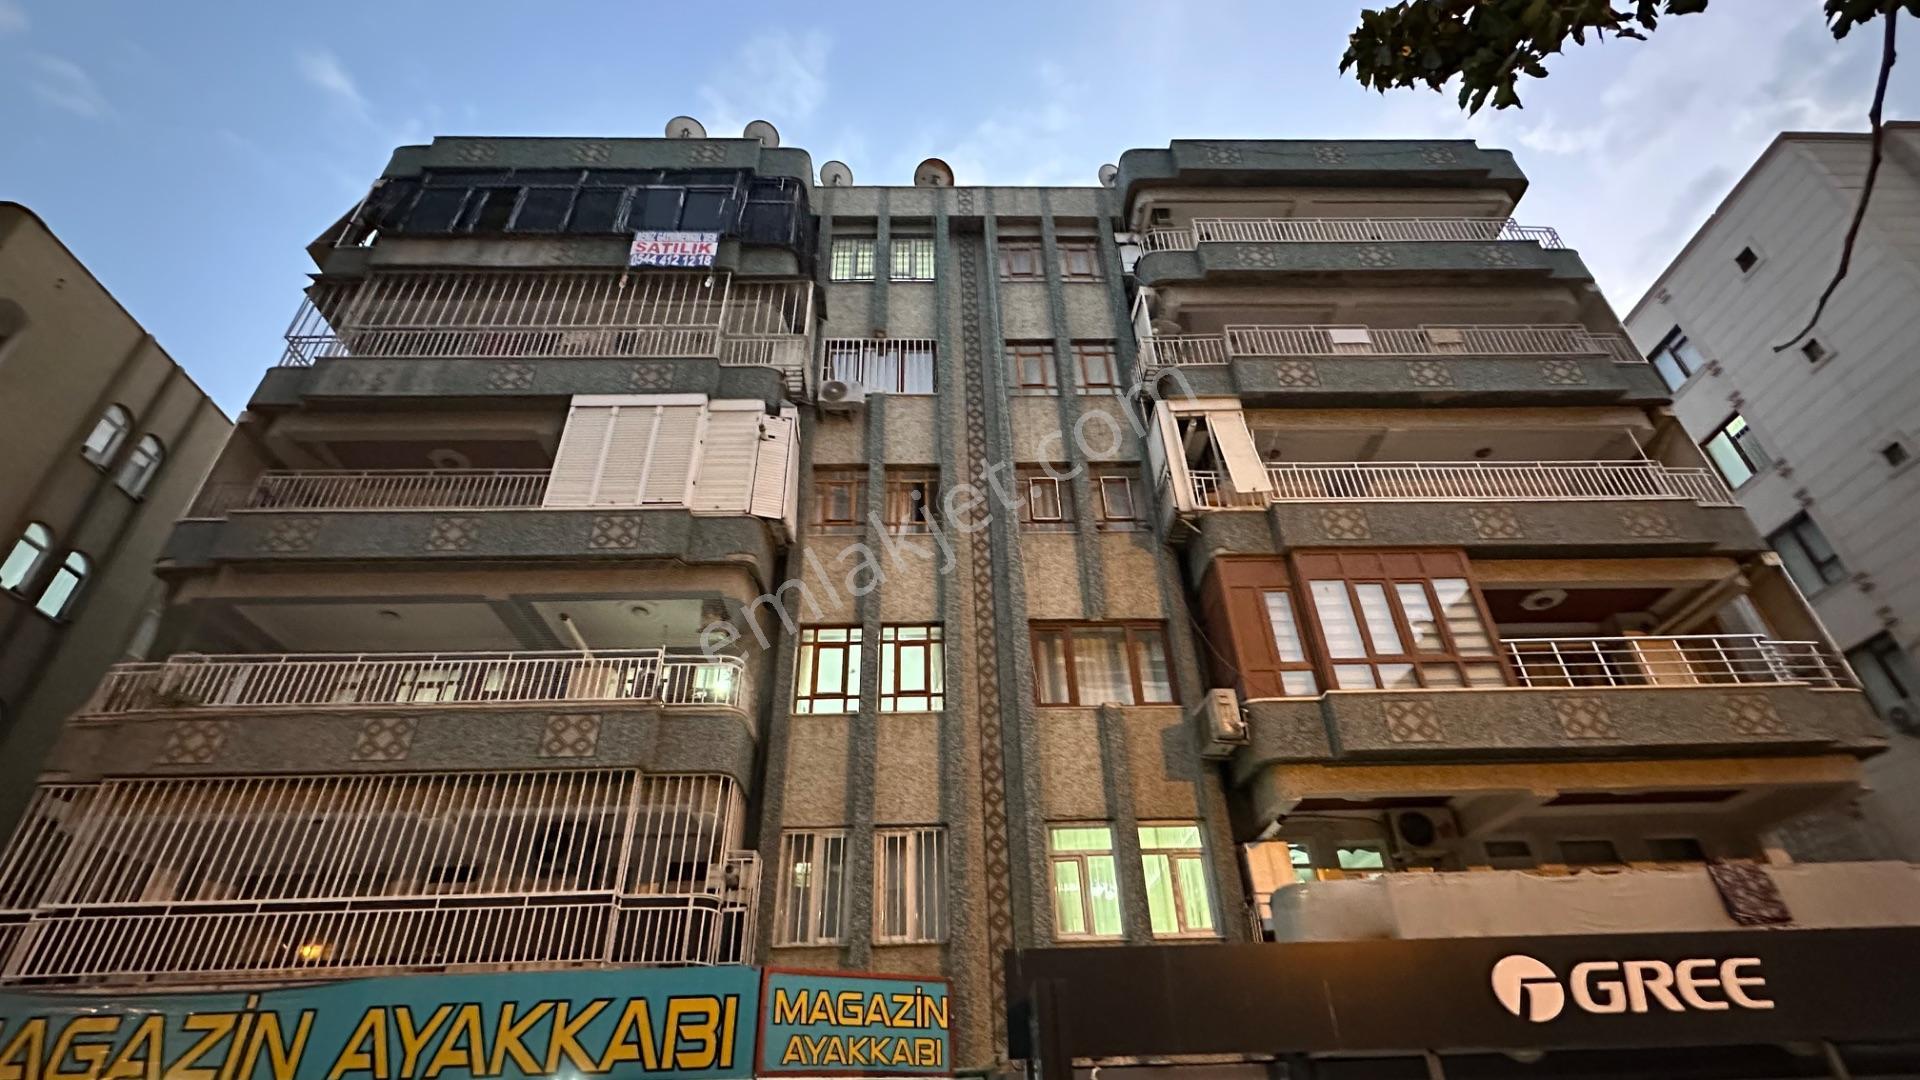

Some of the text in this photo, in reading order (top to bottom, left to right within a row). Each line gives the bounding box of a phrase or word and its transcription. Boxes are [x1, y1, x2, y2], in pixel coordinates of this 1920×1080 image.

[630, 254, 657, 266] 0544
[682, 255, 696, 267] 12
[698, 255, 713, 266] 18
[635, 241, 712, 254] SATILIK
[1570, 958, 1776, 1013] GREE
[773, 985, 949, 1029] MAGAZİN
[0, 993, 741, 1080] AGAZİN AYAKKABI
[781, 1034, 943, 1067] AYAKKABI
